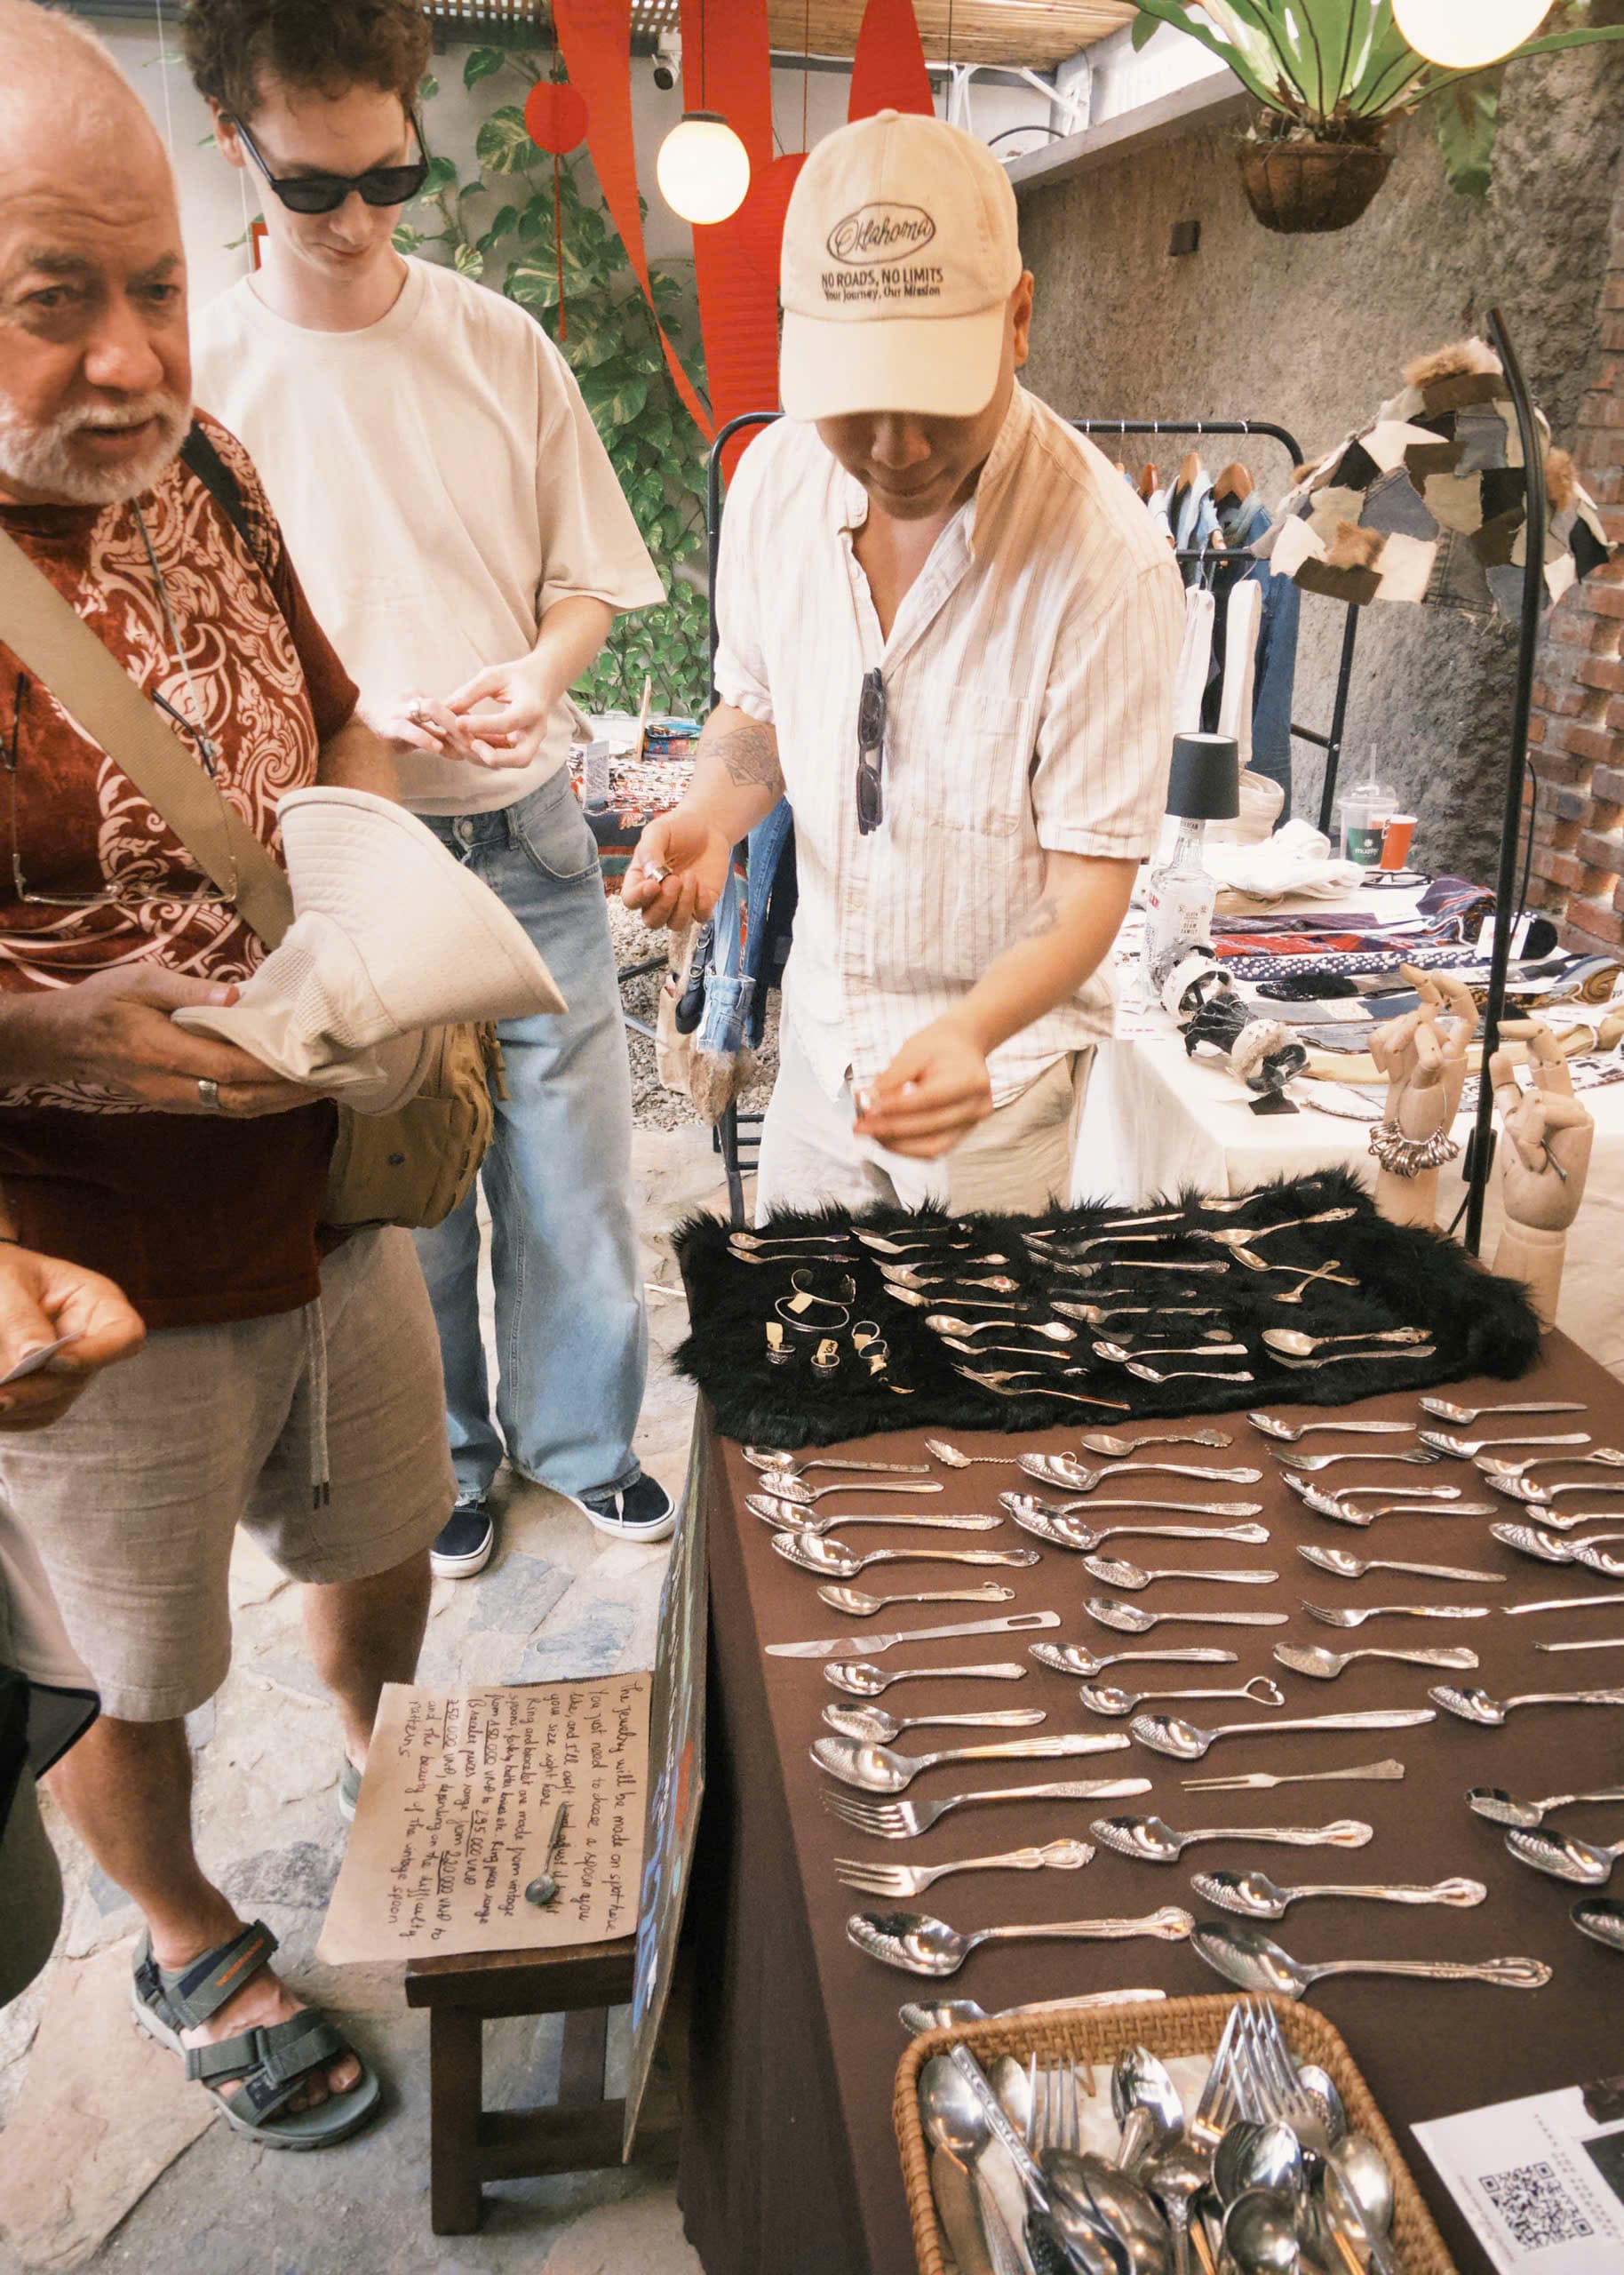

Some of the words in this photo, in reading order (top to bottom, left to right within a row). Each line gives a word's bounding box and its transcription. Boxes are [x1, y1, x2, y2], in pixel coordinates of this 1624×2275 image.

[835, 214, 932, 255] Oklahoma
[822, 274, 834, 287] NO
[837, 273, 880, 288] ROADS,
[881, 270, 900, 283] NO
[904, 268, 943, 283] LIMITS
[824, 289, 841, 301] Your
[884, 286, 901, 299] Our
[904, 285, 940, 297] Mission
[588, 1689, 609, 1709] You
[619, 1680, 644, 1703] The
[425, 1701, 442, 1720] and
[484, 1694, 505, 1717] from
[520, 1697, 541, 1724] Ring
[543, 1694, 560, 1716] your
[545, 1723, 558, 1745] size
[566, 1720, 579, 1738] and
[584, 1713, 608, 1734] just
[423, 1728, 441, 1748] the
[523, 1728, 539, 1744] and
[458, 1750, 476, 1777] prices
[539, 1753, 557, 1779] right
[591, 1743, 609, 1768] need
[404, 1756, 435, 1793] beauty
[501, 1765, 519, 1788] butter
[591, 1777, 604, 1789] to
[615, 1760, 637, 1787] will
[403, 1801, 426, 1812] of
[453, 1784, 474, 1811] range
[518, 1791, 529, 1805] are
[613, 1792, 637, 1808] be
[587, 1793, 609, 1828] choose
[406, 1818, 425, 1837] the
[446, 1820, 470, 1846] from
[514, 1811, 532, 1840] made
[611, 1816, 631, 1847] made
[430, 1835, 440, 1847] on
[482, 1841, 505, 1864] Ring
[585, 1838, 598, 1847] a
[390, 1842, 417, 1880] vintage
[421, 1851, 440, 1868] the
[506, 1848, 527, 1875] from
[574, 1852, 597, 1888] spoon
[609, 1855, 621, 1868] on
[482, 1866, 498, 1889] prices
[601, 1874, 625, 1902] spot
[387, 1886, 404, 1924] spoon
[399, 1876, 434, 1937] difficulty
[474, 1893, 493, 1924] range
[498, 1880, 520, 1917] vintage
[570, 1893, 592, 1920] you
[431, 1928, 447, 1940] to
